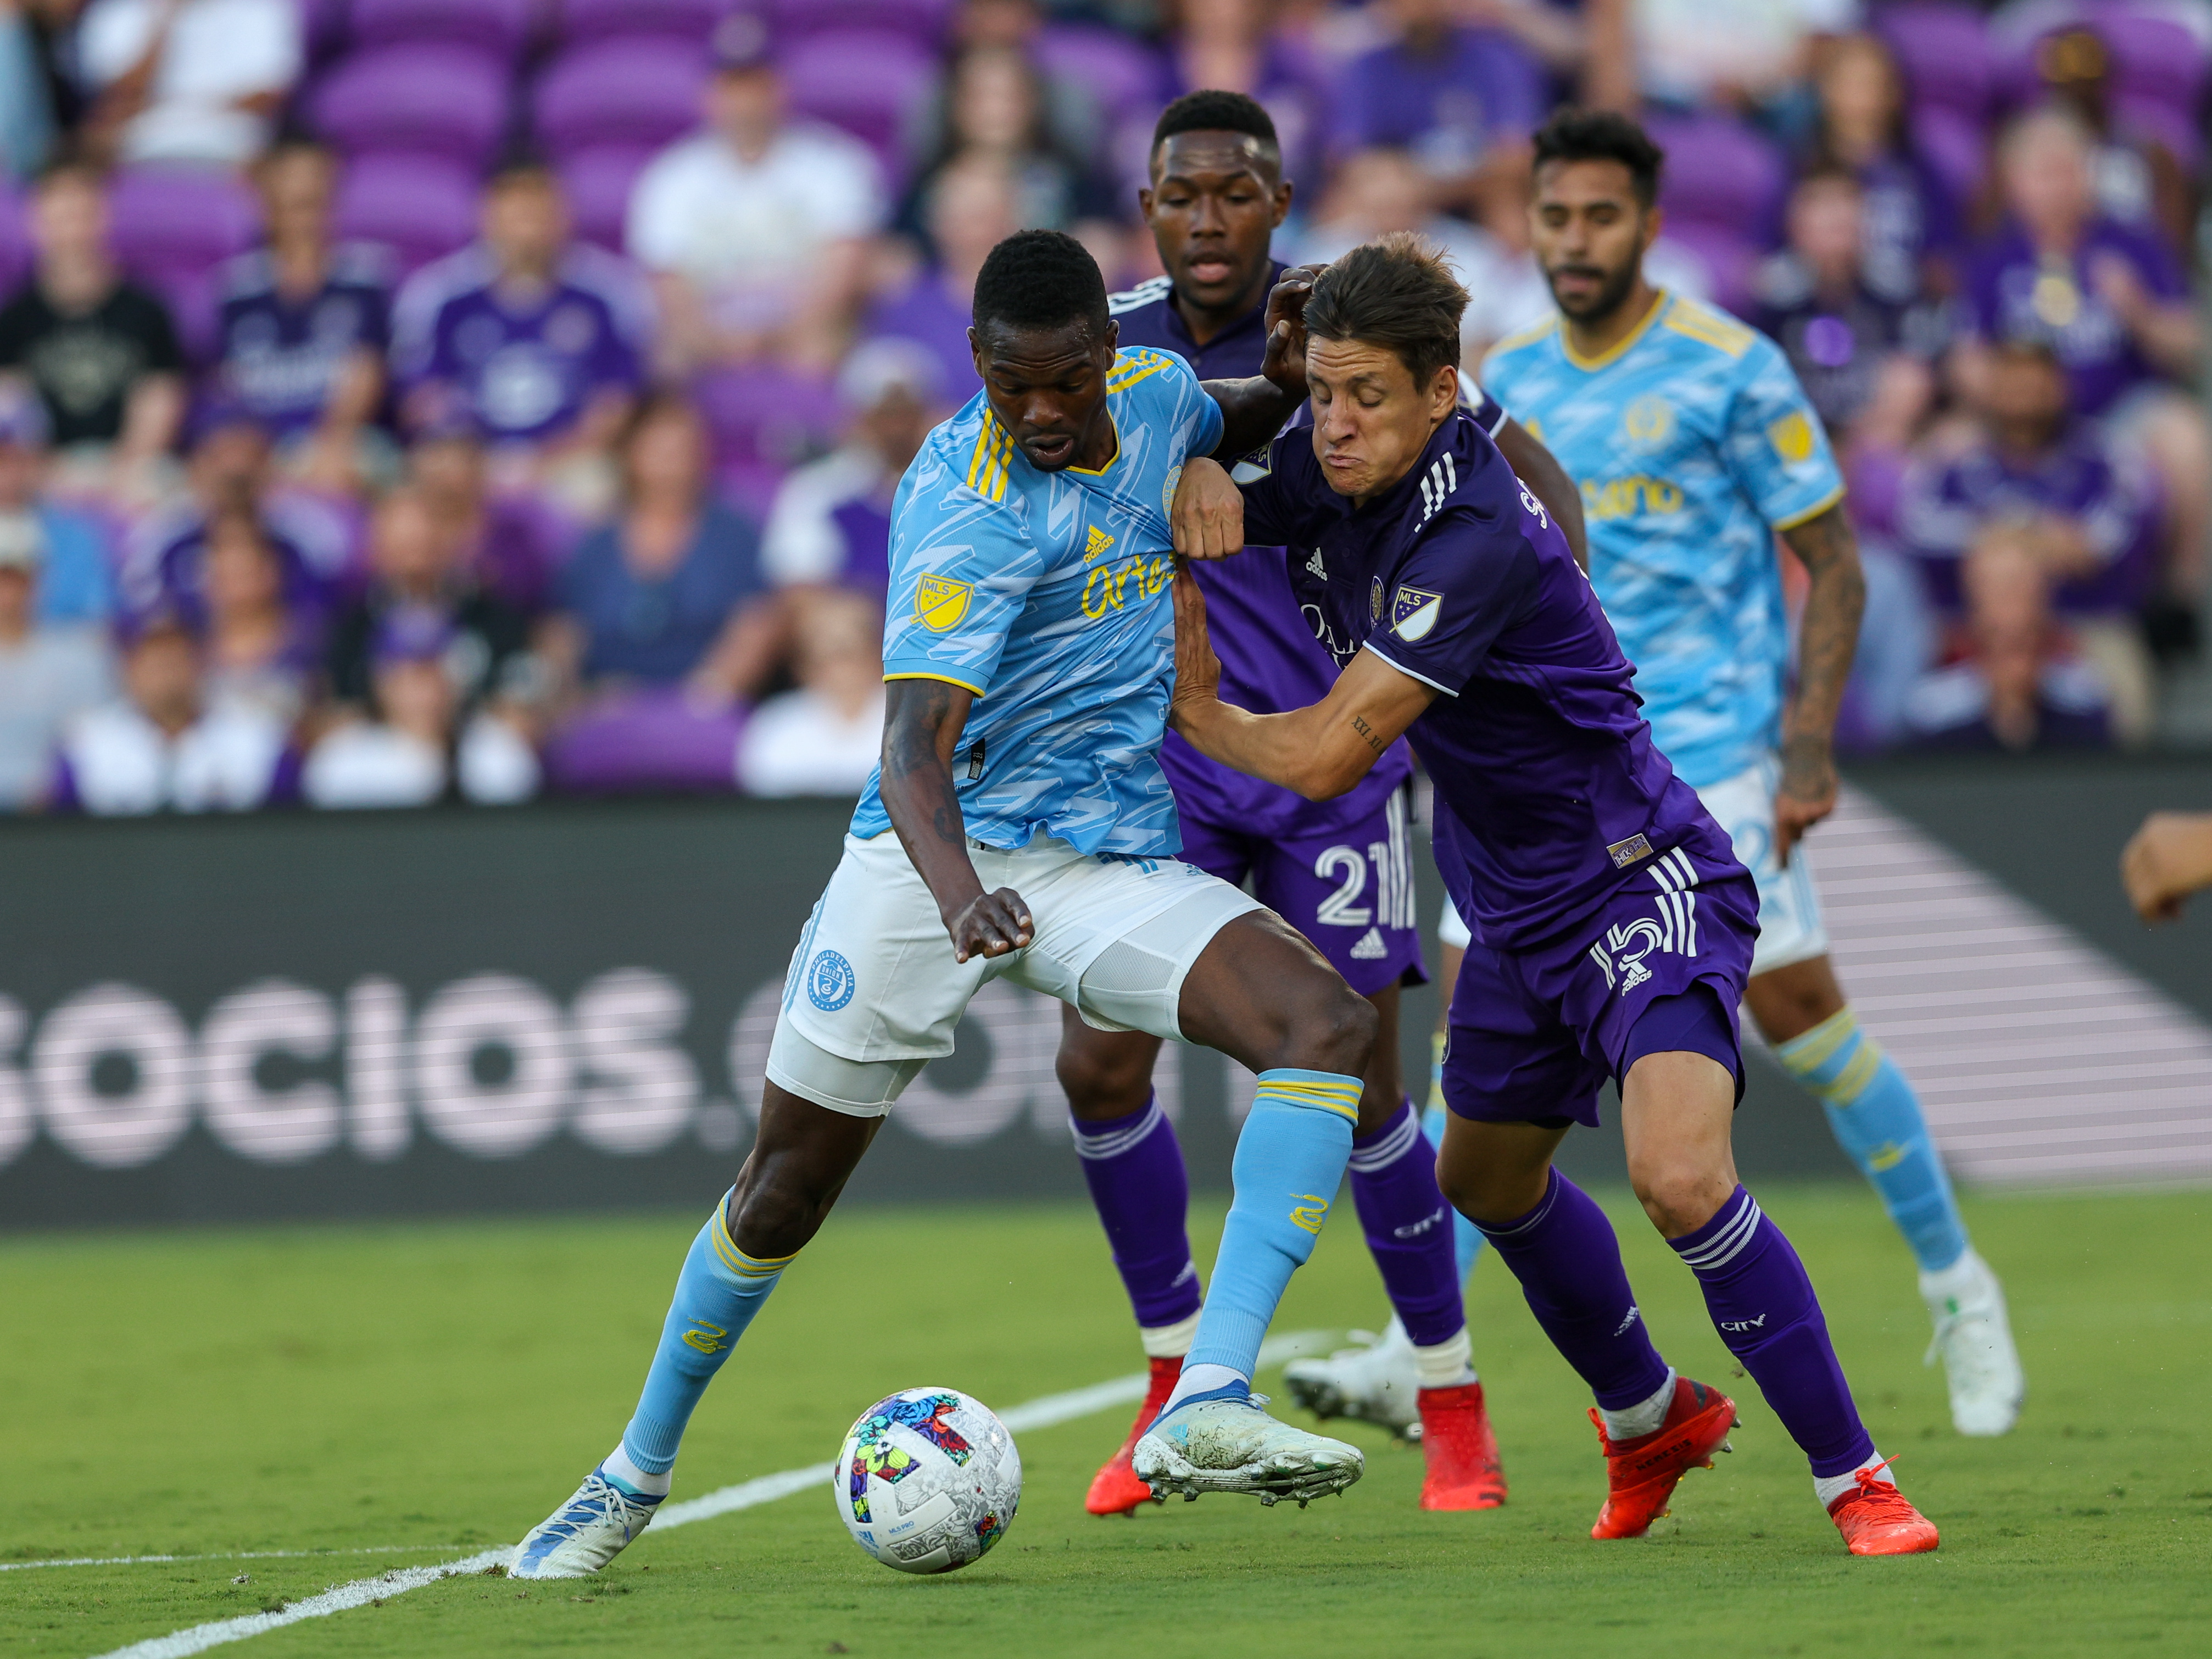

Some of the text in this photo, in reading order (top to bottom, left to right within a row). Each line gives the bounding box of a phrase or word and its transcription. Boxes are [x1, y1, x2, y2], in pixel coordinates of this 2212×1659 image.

[1083, 535, 1115, 563] adidas
[924, 581, 950, 595] MLS
[1398, 591, 1422, 606] MLS
[1614, 847, 1632, 865] THICK
[1631, 835, 1646, 851] THIN
[1314, 841, 1390, 926] 21
[1589, 917, 1664, 991] 15
[812, 951, 854, 987] PHILADELPHIA
[821, 965, 841, 979] UNION
[1394, 1206, 1445, 1239] CITY
[1720, 1313, 1766, 1332] CITY
[888, 1526, 901, 1534] MLS
[901, 1521, 915, 1529] PRO
